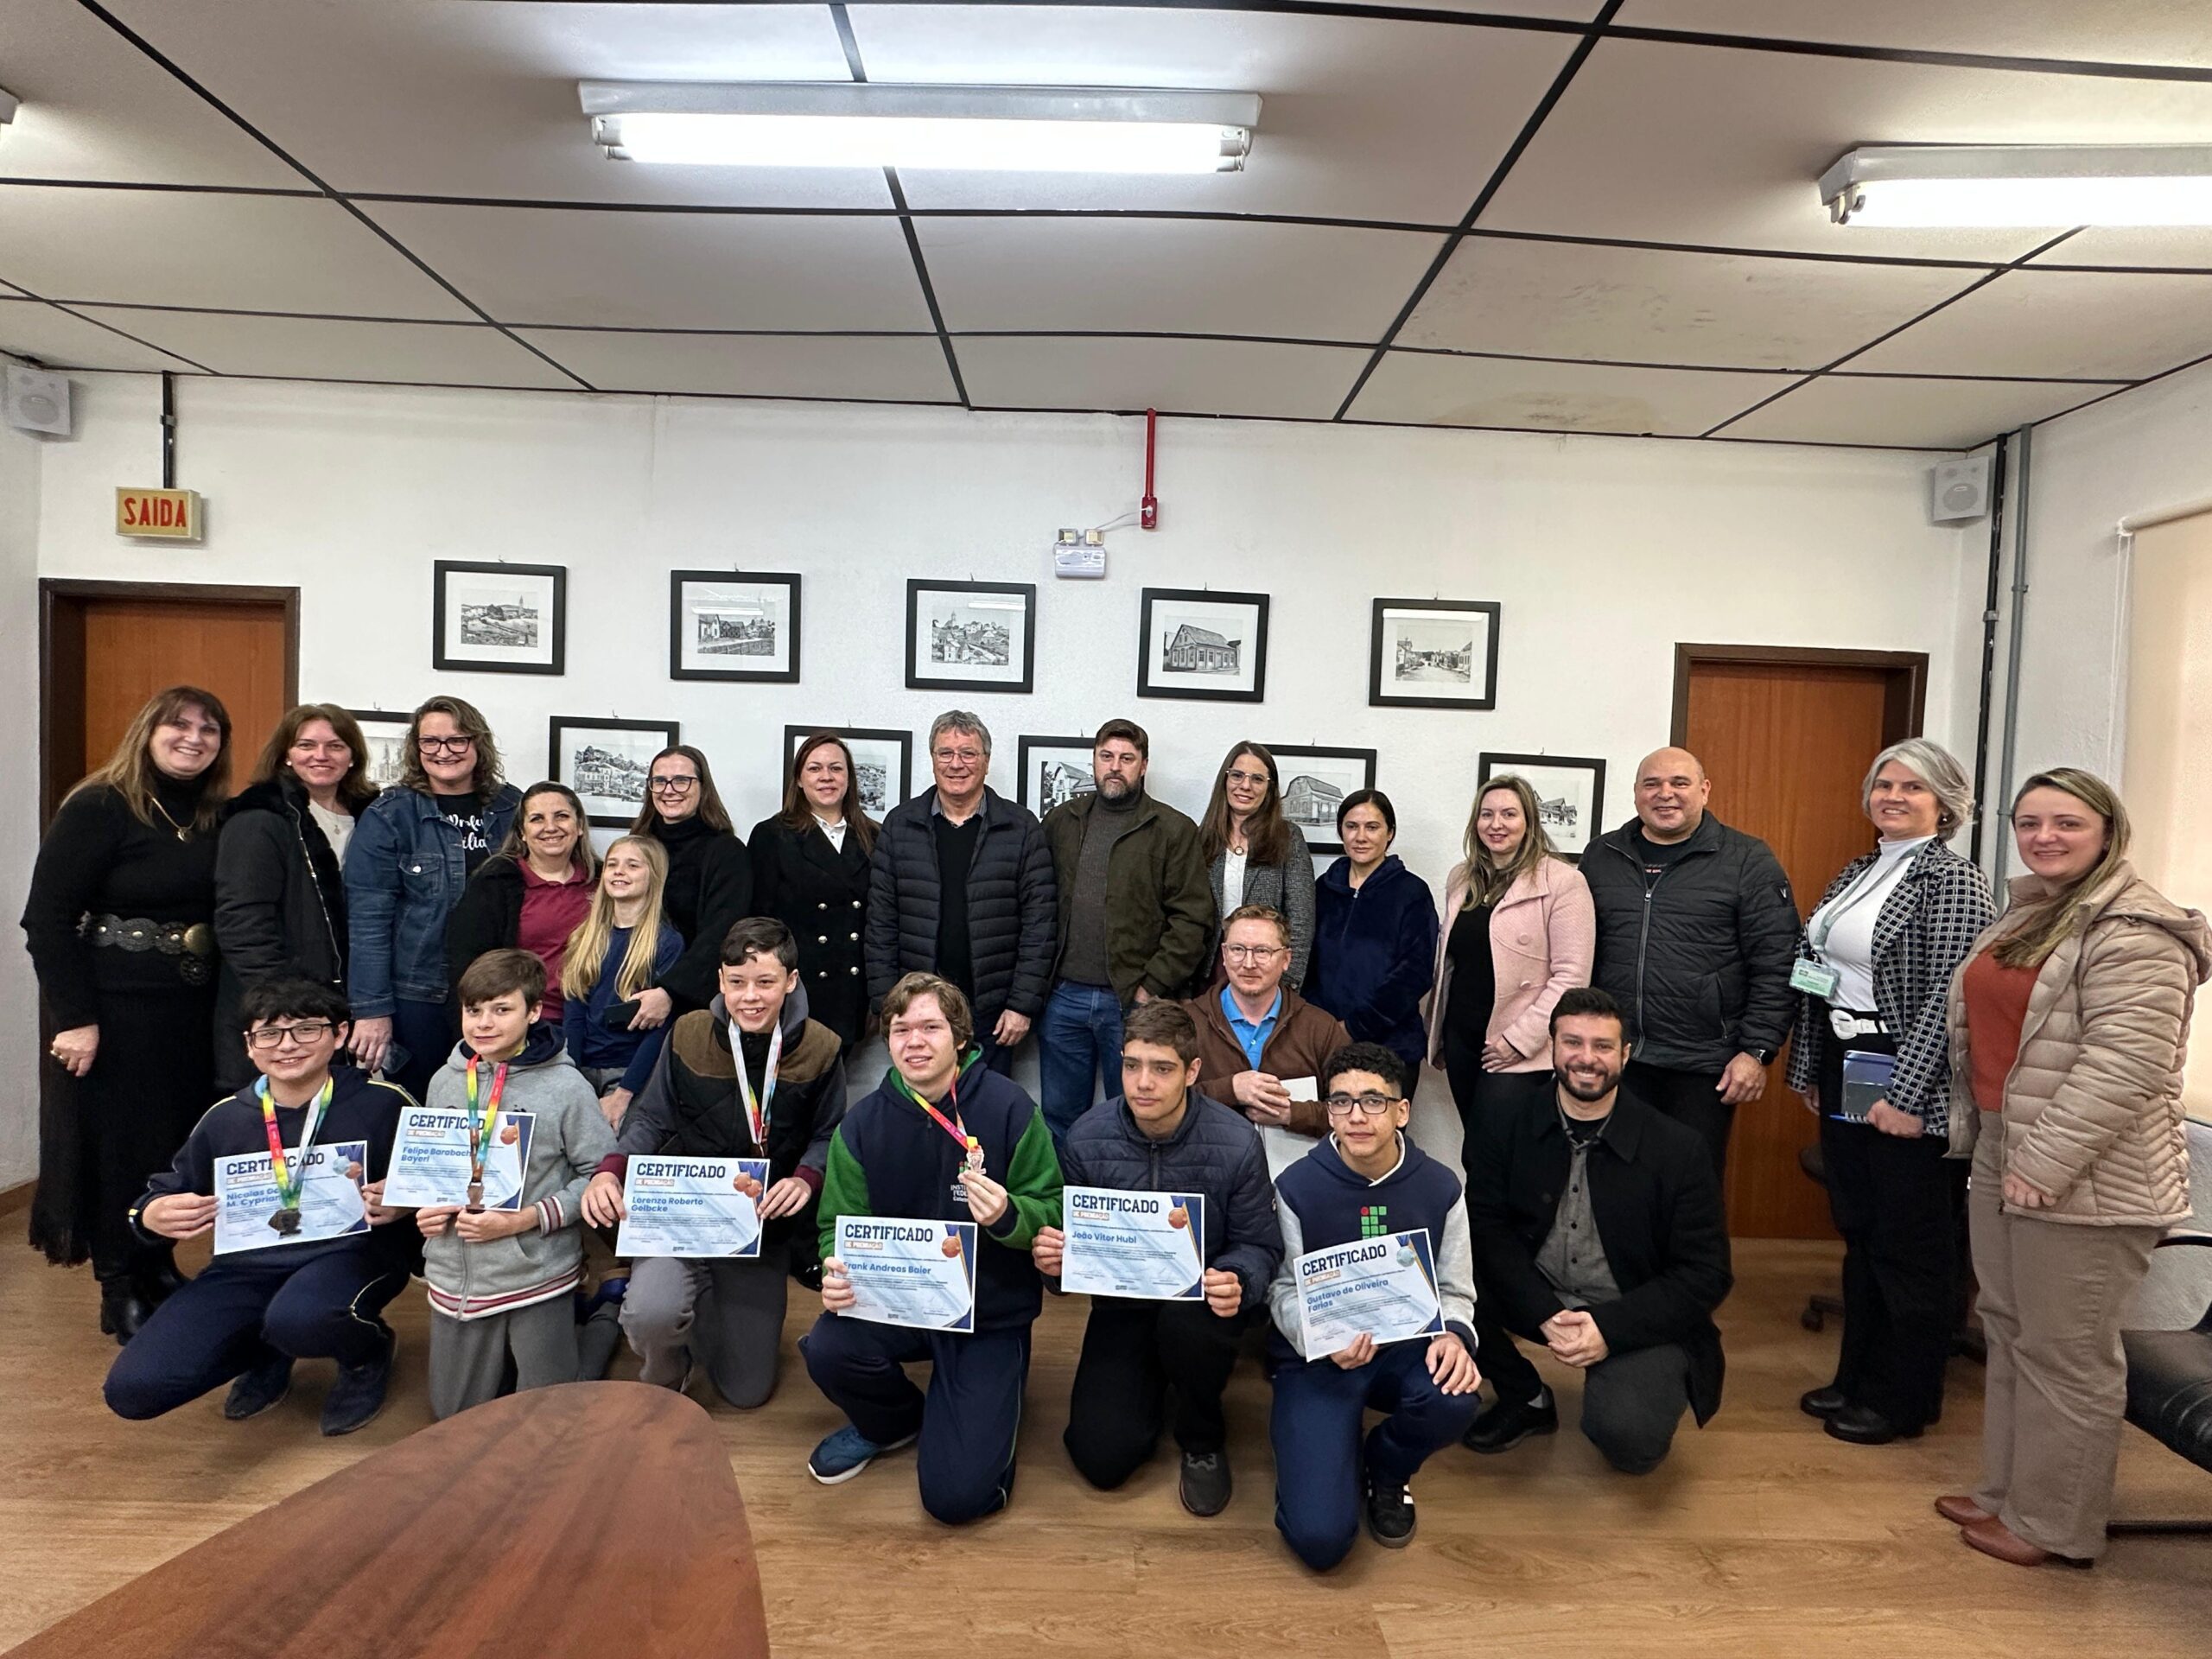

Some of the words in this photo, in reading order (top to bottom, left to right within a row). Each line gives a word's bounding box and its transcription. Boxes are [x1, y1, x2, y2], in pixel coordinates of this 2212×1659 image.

[409, 1114, 486, 1130] CERTIFICD
[403, 1147, 429, 1156] Felipe
[636, 1162, 726, 1179] CERTIFICADO
[632, 1196, 667, 1205] Lorenzo
[668, 1197, 704, 1205] Roberto
[1072, 1194, 1159, 1213] CERTIFICADO
[845, 1224, 933, 1243] CERTIFICADO
[1071, 1230, 1093, 1240] João
[1094, 1231, 1115, 1243] Vitor
[869, 1262, 906, 1273] Andreas
[1302, 1244, 1388, 1276] CERTIFICADO
[1306, 1289, 1341, 1305] Gustavo
[1342, 1284, 1354, 1295] de
[1355, 1278, 1389, 1292] Oliveira
[1307, 1300, 1333, 1313] Farias
